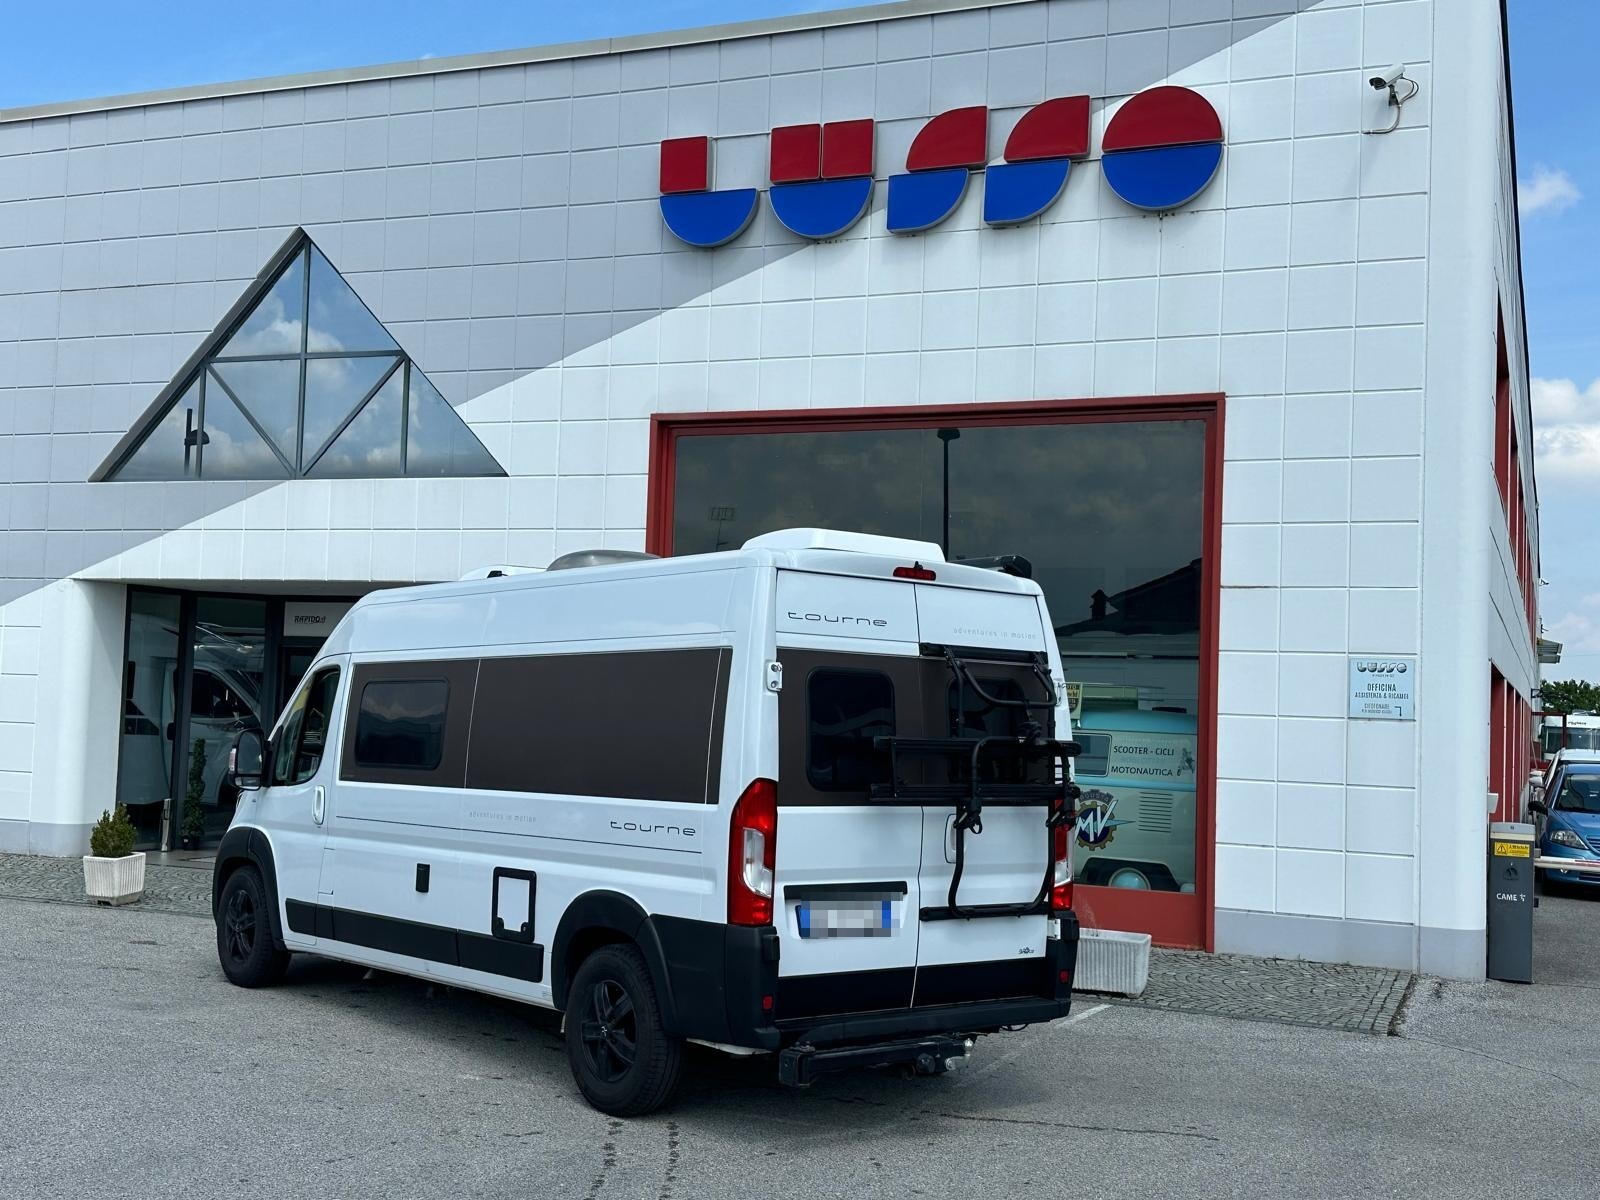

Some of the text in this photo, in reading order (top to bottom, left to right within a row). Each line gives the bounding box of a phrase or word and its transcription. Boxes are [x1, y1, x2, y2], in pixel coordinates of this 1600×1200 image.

[660, 85, 1224, 248] LUSSO
[787, 611, 888, 627] tourne
[953, 627, 998, 638] adventures
[1011, 631, 1037, 640] motion
[1367, 683, 1397, 692] OFFICINA
[1113, 745, 1148, 755] SCOOTER
[1155, 747, 1175, 756] CICLI
[1111, 766, 1173, 777] MOTONAUTICA
[610, 820, 696, 837] tourne
[1496, 893, 1518, 902] CAME
